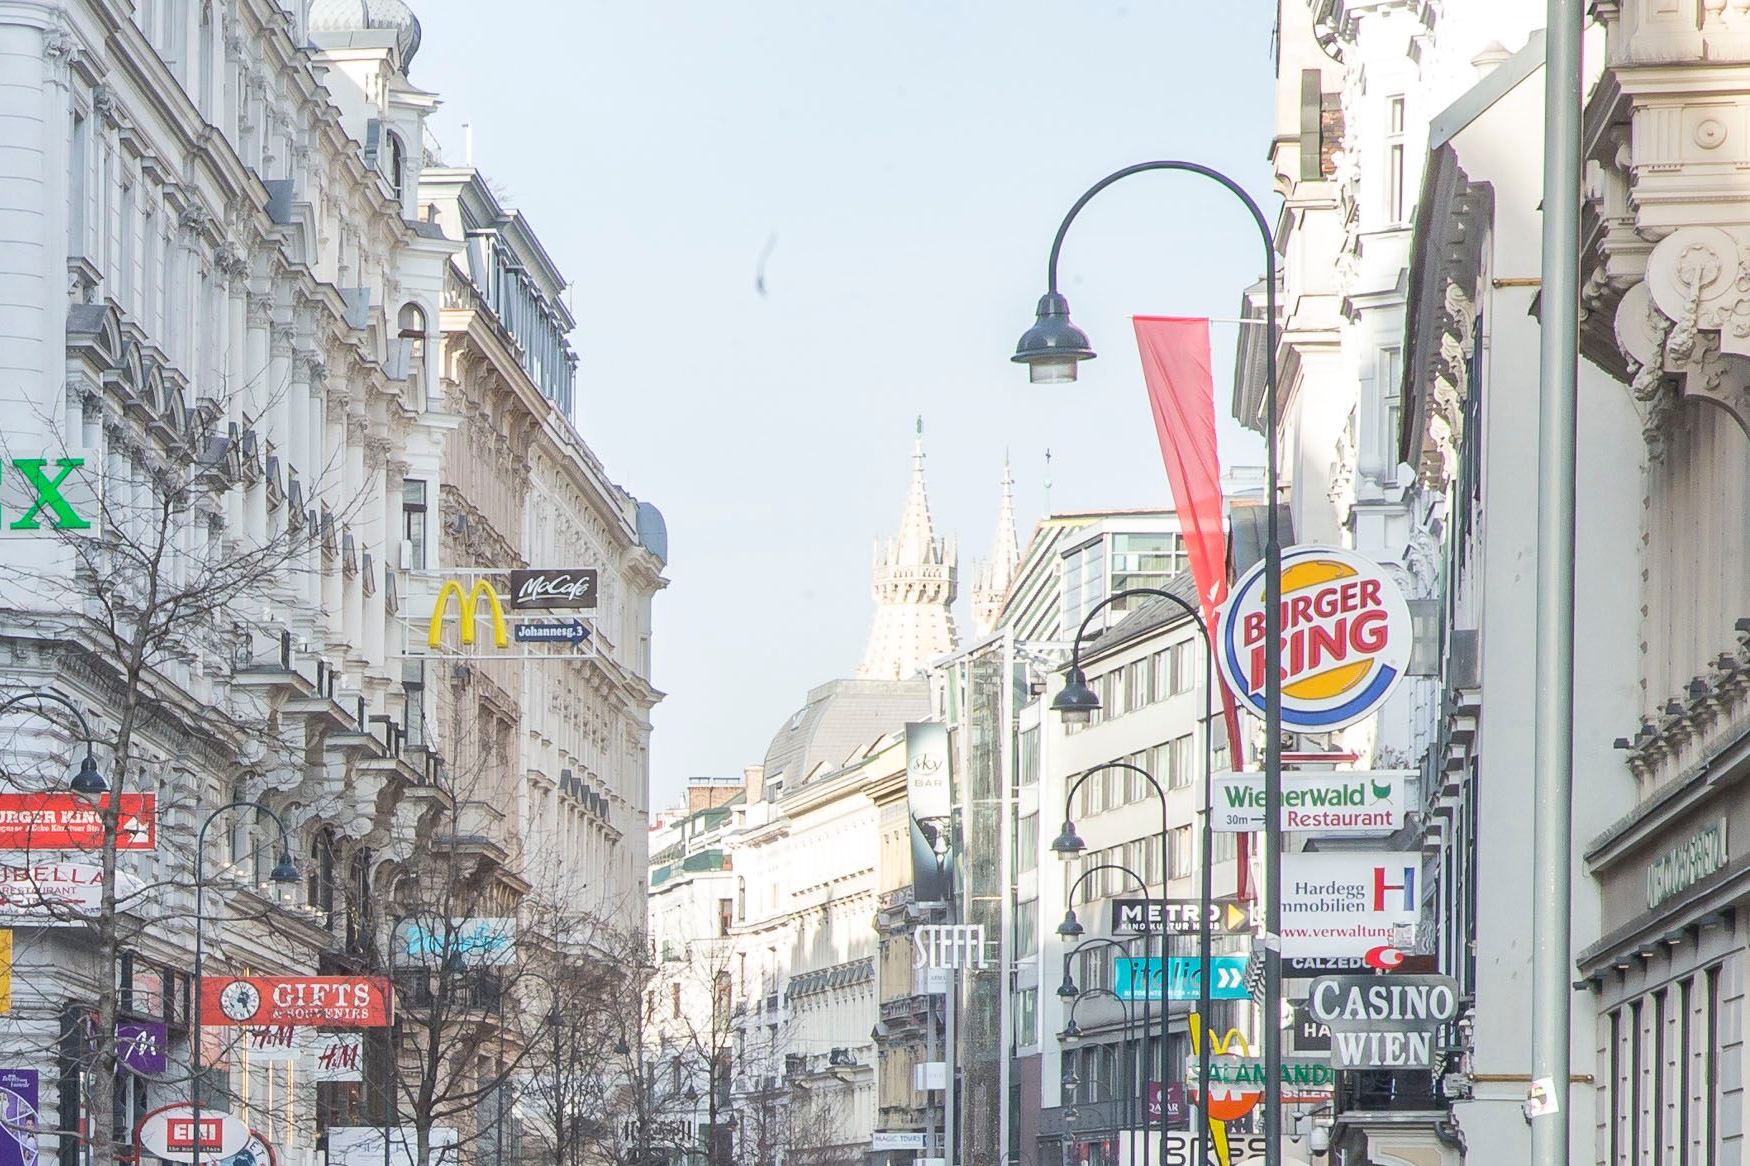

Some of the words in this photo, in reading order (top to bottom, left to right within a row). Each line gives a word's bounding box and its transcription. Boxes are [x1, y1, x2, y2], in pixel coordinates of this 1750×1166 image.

[1243, 579, 1383, 647] BURGER
[1250, 609, 1389, 692] KING
[914, 779, 942, 787] BAR
[1224, 783, 1365, 808] Wieerwald
[1226, 814, 1249, 825] 30m
[1287, 810, 1393, 827] Restaurant
[1295, 881, 1366, 899] Hardegg
[1282, 898, 1366, 912] mmobilien
[1150, 922, 1188, 931] KUTUR
[914, 924, 989, 968] STEFFL
[272, 983, 370, 1008] GIFTS
[1313, 980, 1454, 1020] CASINO
[287, 1007, 370, 1020] SOUVENIRS
[251, 1026, 294, 1049] H&M
[1304, 1023, 1331, 1038] HA
[319, 1042, 358, 1070] H&M
[1335, 1031, 1431, 1066] WIEN
[1192, 1063, 1334, 1085] SALAMAND
[1148, 1103, 1179, 1115] QAAR
